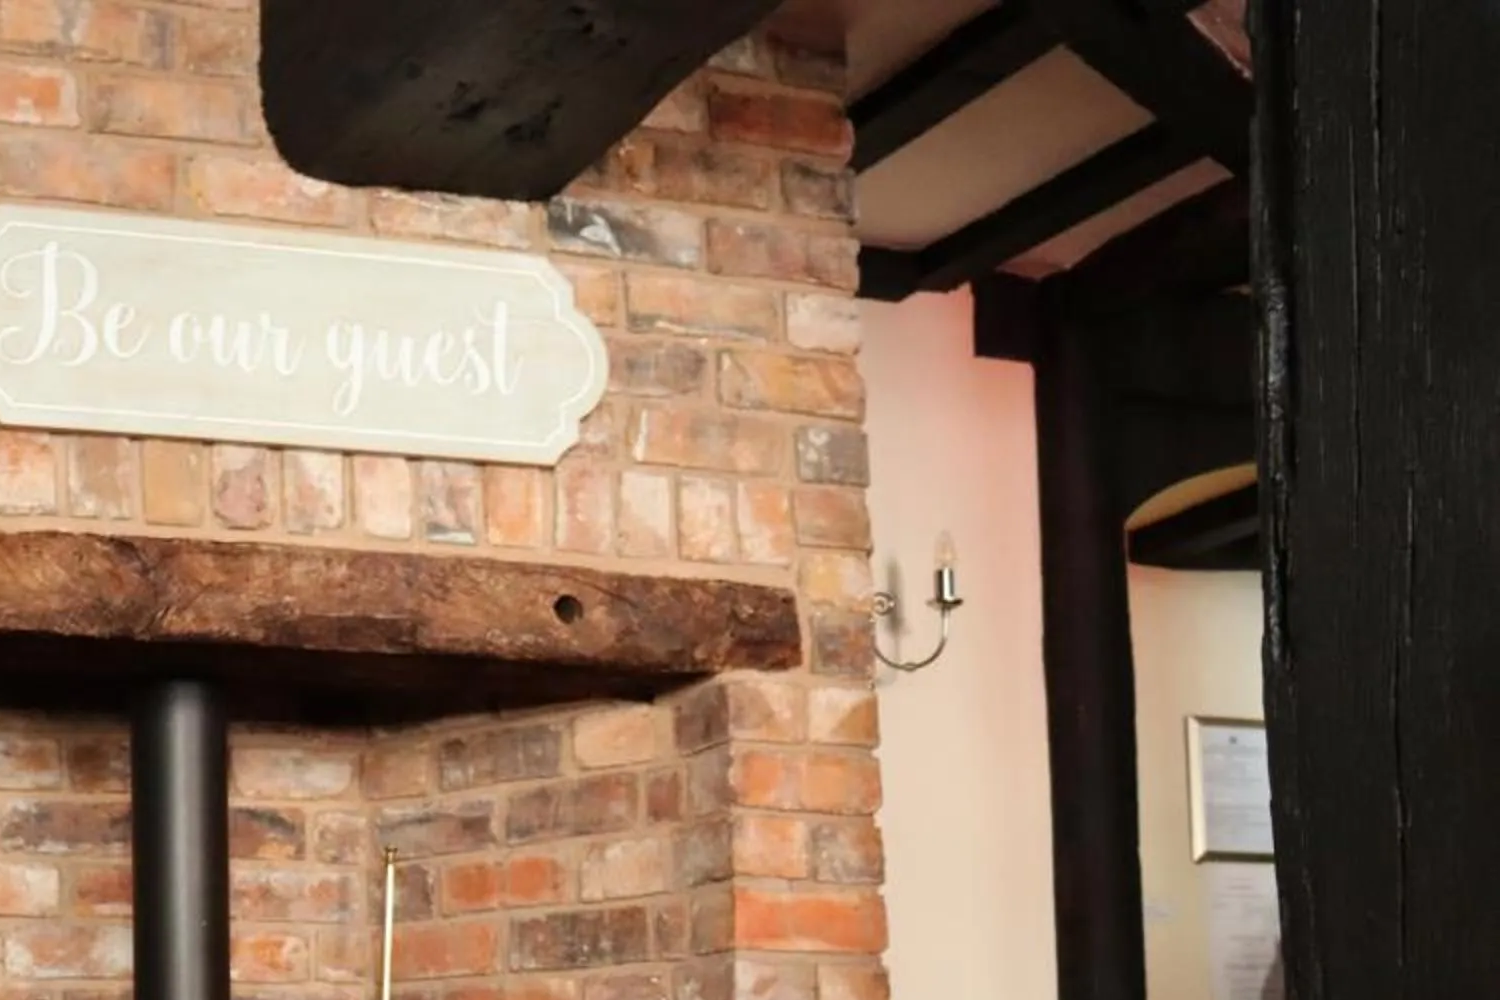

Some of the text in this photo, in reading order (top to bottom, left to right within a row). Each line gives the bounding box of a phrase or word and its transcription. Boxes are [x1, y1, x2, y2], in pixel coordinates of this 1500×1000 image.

[0, 242, 546, 416] Be our guest
